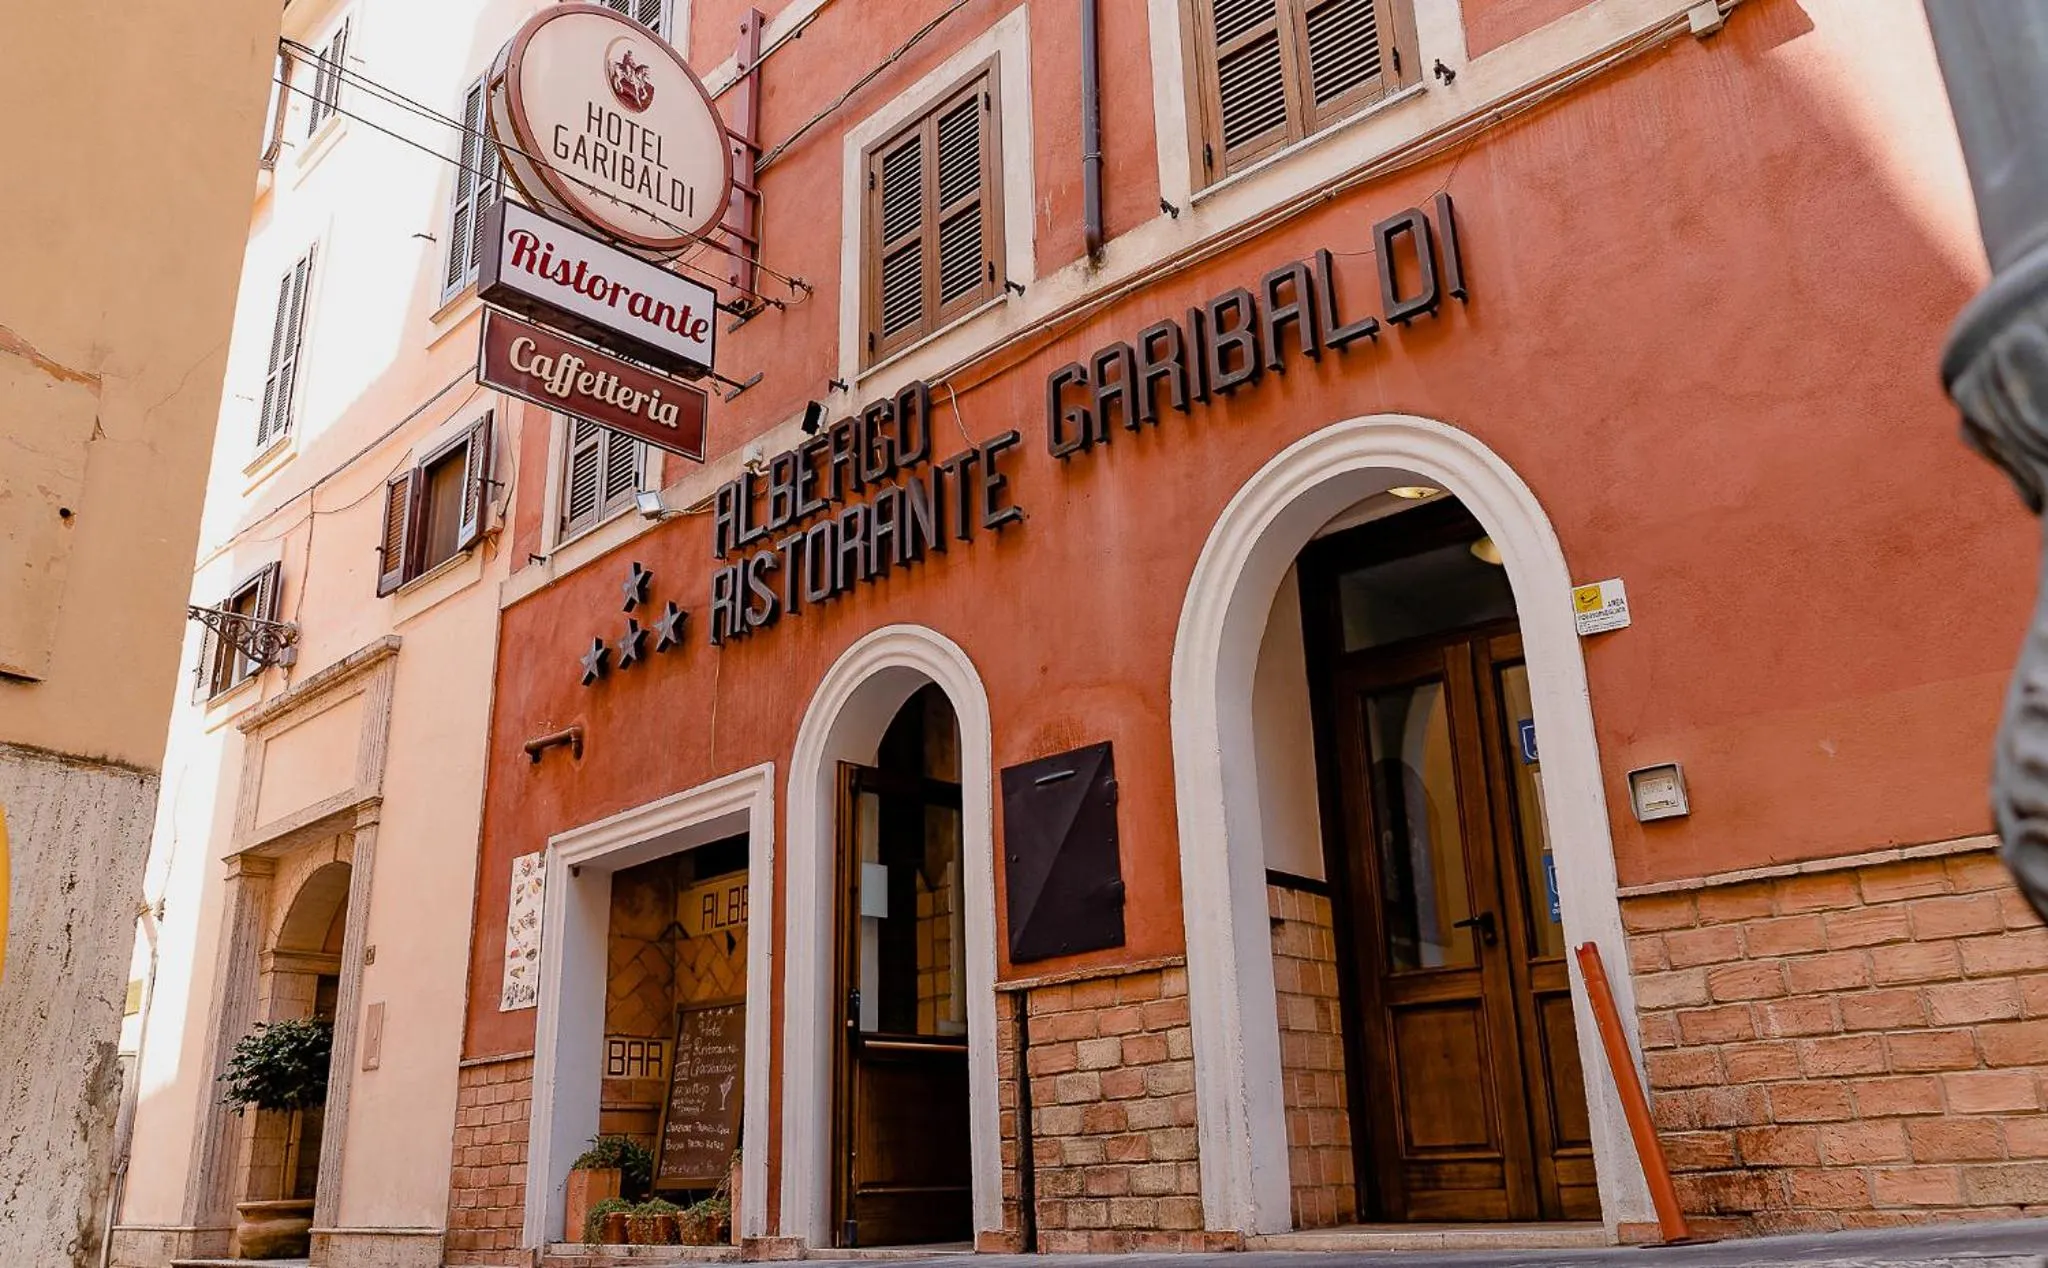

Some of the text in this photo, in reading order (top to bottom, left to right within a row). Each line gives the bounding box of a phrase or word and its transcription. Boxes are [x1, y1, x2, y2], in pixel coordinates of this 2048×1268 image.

[553, 124, 696, 219] GARIBALDI
[586, 101, 669, 170] HOTEL
[508, 227, 710, 344] Ristorante
[1047, 194, 1468, 461] GARIBALDI
[509, 336, 679, 429] Caffetteria
[713, 380, 930, 560] ALBERGO
[710, 429, 1024, 646] RISTORANTE
[608, 1040, 663, 1076] BAR
